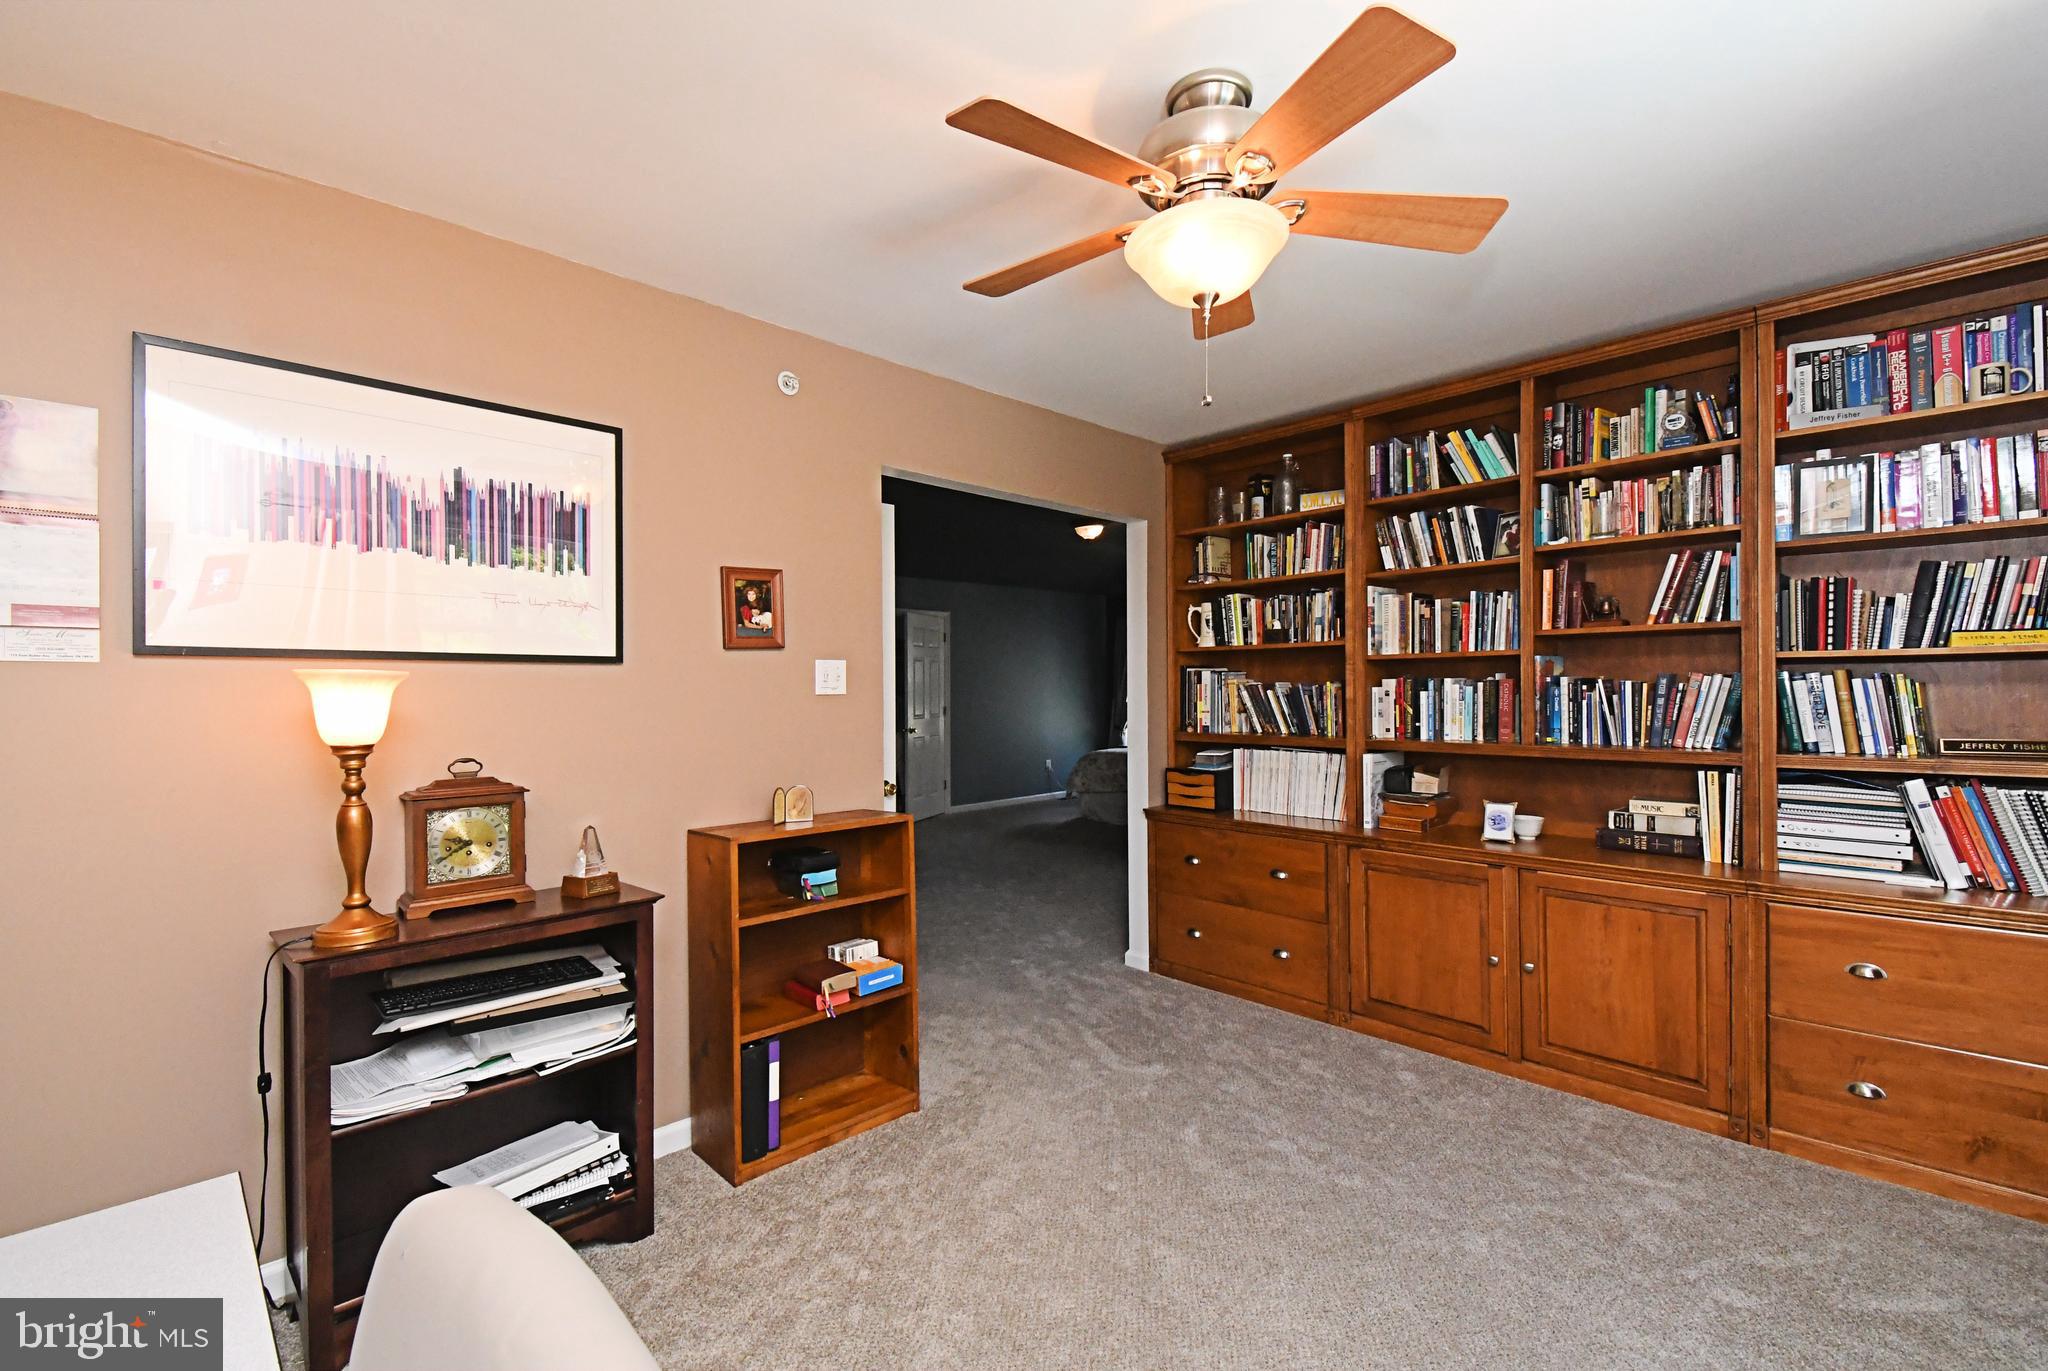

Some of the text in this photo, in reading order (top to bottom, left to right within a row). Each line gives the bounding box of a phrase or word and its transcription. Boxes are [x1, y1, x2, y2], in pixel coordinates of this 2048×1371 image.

[1942, 333, 1951, 353] Visual
[1891, 351, 1900, 391] RECIPES
[1942, 354, 1951, 366] C++
[1822, 363, 1830, 380] RFID
[1899, 350, 1908, 408] NUMERICAL
[1918, 369, 1926, 396] Primer
[1859, 379, 1867, 405] PowerShell
[1809, 410, 1861, 424] Jeffrey Fisher
[1610, 422, 1619, 451] WORKING
[1952, 473, 1961, 500] Development
[1815, 708, 1826, 730] LOVE
[1960, 742, 2006, 750] JEFFREY
[1640, 804, 1664, 813] MUSIC
